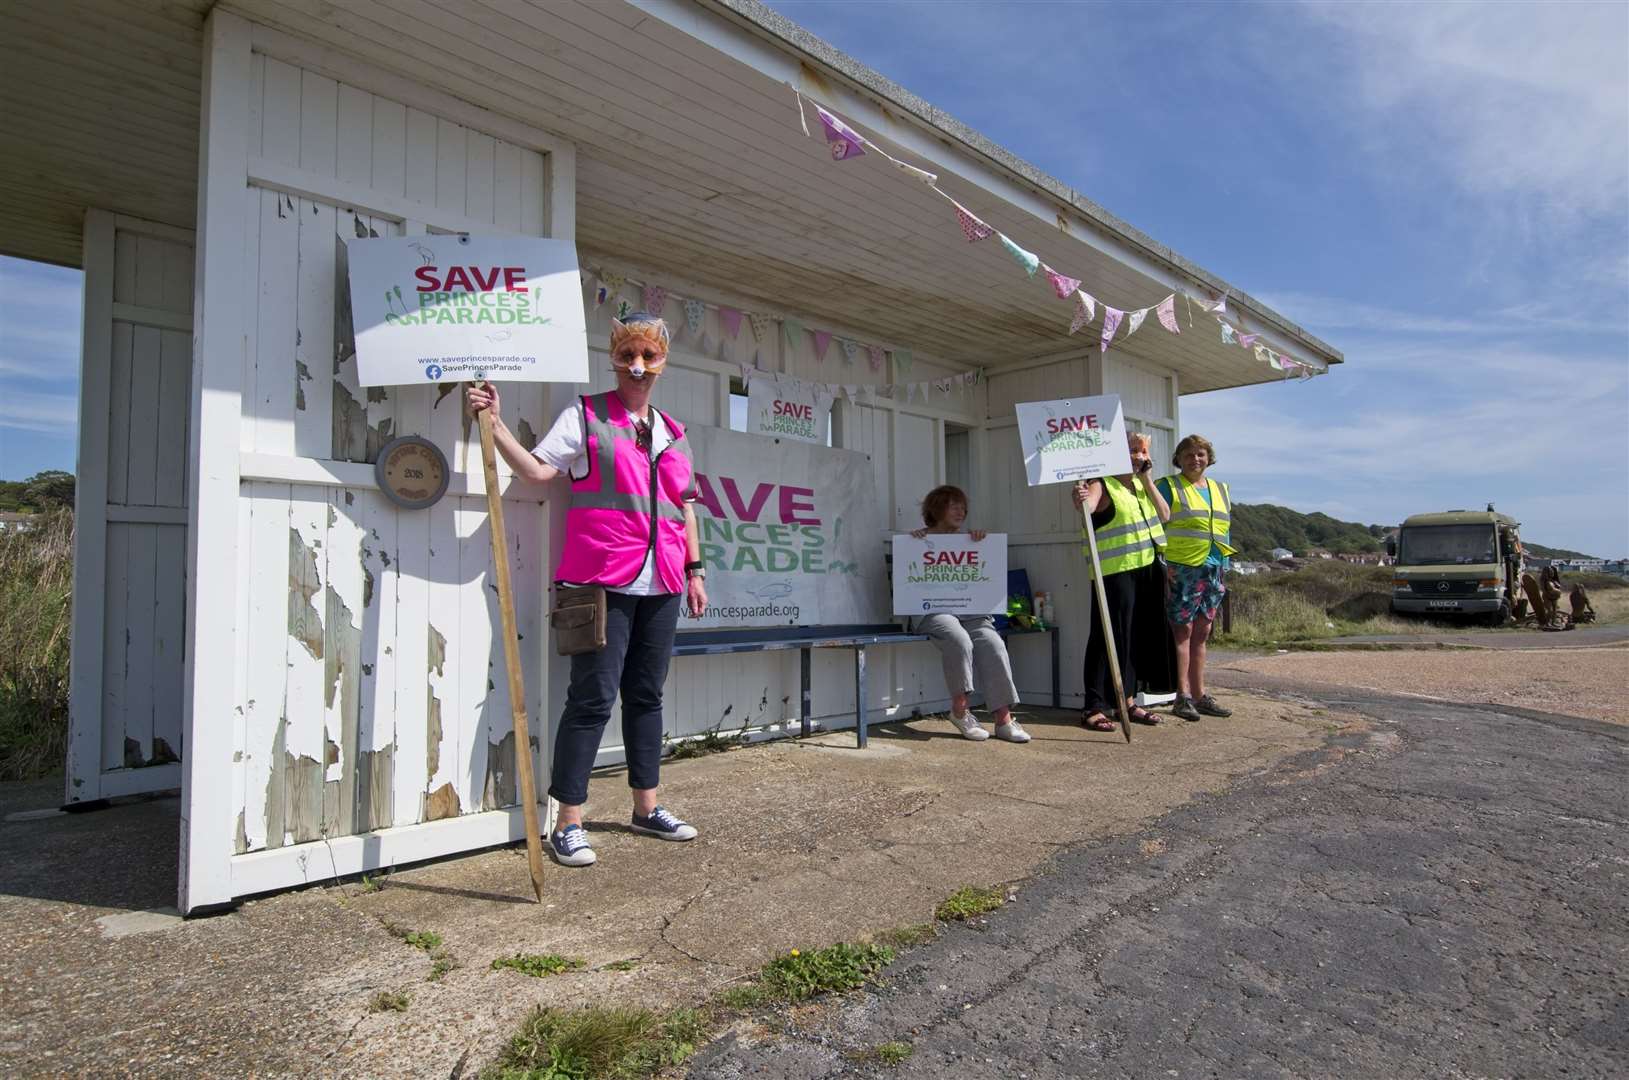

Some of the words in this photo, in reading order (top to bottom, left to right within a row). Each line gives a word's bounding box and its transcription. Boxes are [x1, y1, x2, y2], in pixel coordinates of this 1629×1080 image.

[414, 266, 528, 293] SAVE
[418, 292, 530, 308] PRINCE'S
[420, 308, 531, 325] PARADE
[417, 355, 536, 365] www.saveprincesparade.org
[442, 364, 522, 373] SavePrincesParade
[773, 399, 812, 420] SAVE
[773, 423, 814, 438] PARADE
[1046, 414, 1099, 434] SAVE
[1052, 437, 1101, 453] PARADE
[694, 472, 822, 526] AVE
[697, 516, 825, 548] NCE'S
[699, 543, 826, 574] RADE
[923, 551, 979, 565] SAVE
[924, 573, 979, 582] PARADE
